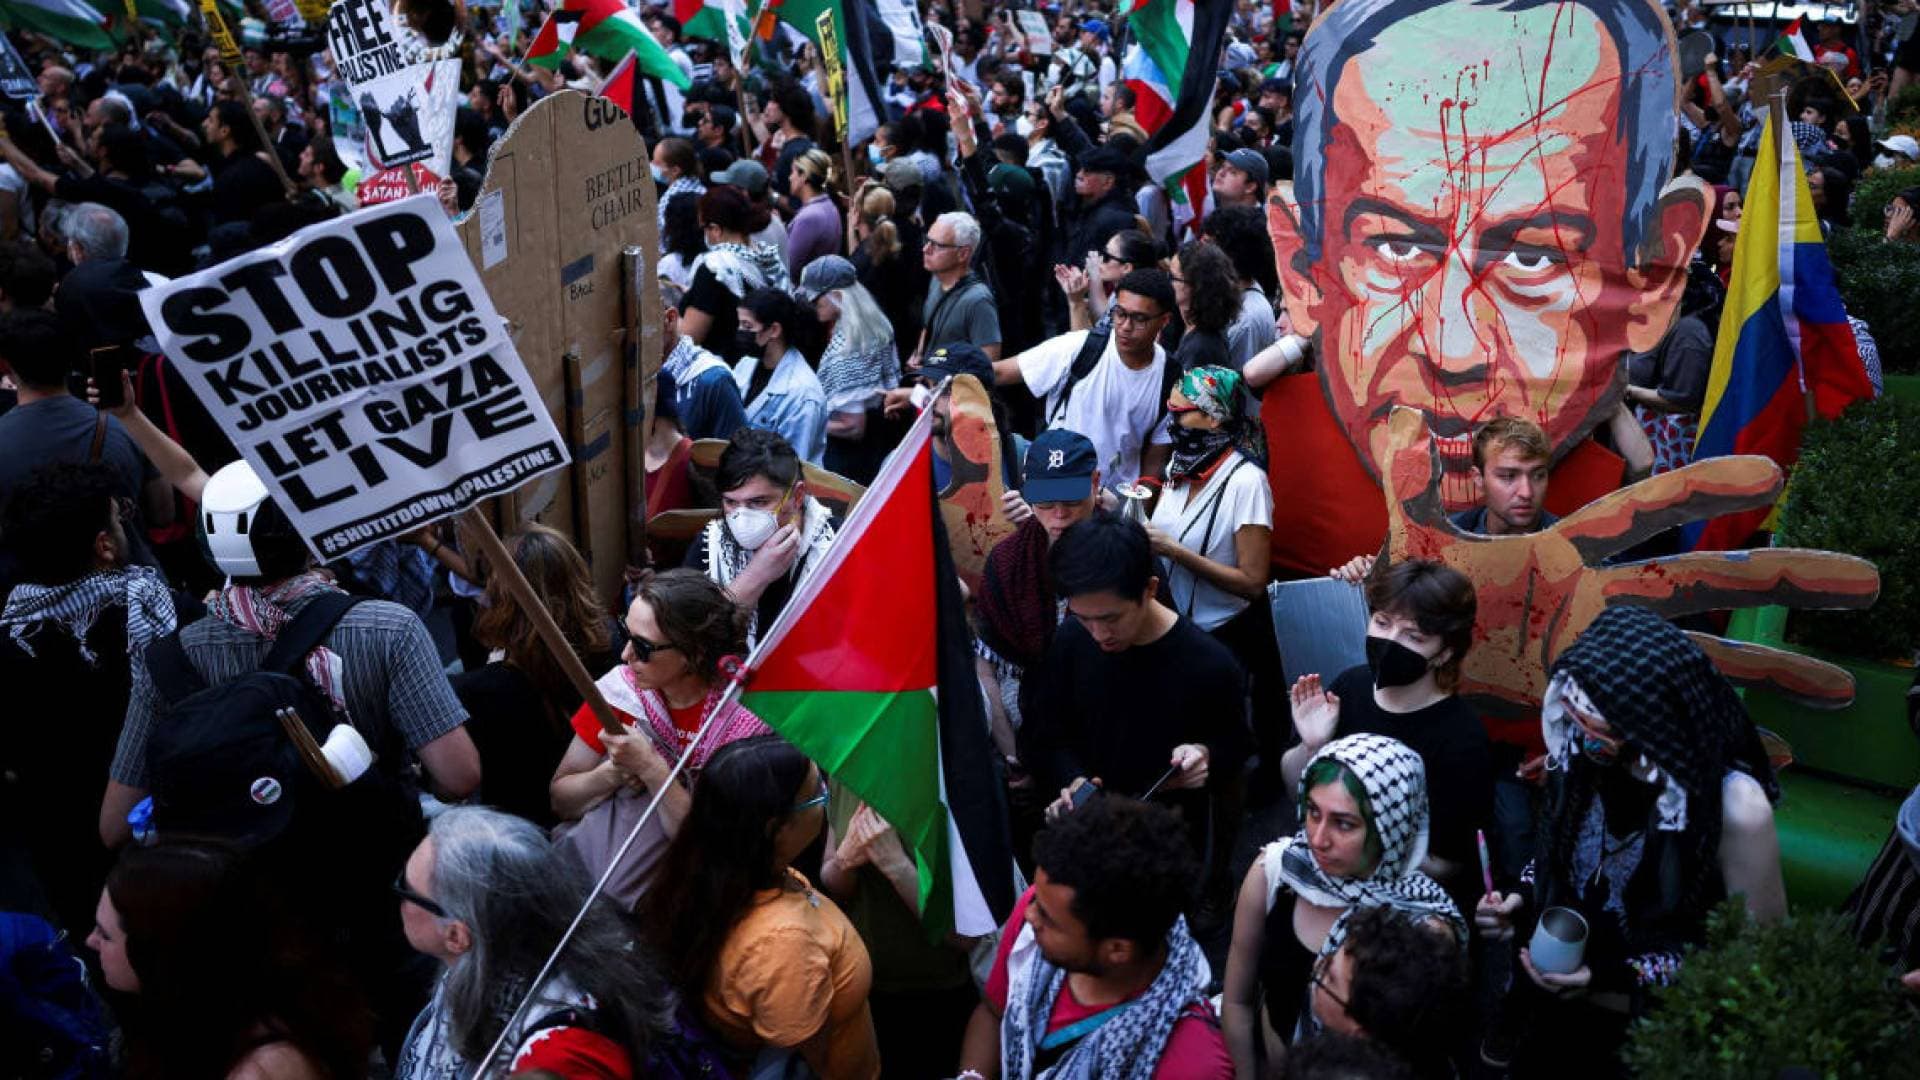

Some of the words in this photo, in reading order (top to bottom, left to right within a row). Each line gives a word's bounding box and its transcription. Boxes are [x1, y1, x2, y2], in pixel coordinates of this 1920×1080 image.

[329, 0, 393, 61] FREE
[585, 156, 647, 203] BEETLE
[591, 187, 643, 231] CHAIR
[161, 213, 436, 364] STOP
[203, 280, 475, 406] KILLING
[236, 316, 488, 432] JOURNALISTS
[254, 409, 353, 478] LET
[363, 352, 514, 435] GAZA
[278, 385, 537, 514] LIVE
[321, 446, 556, 553] #SHUTITDOWN4PALESTINE
